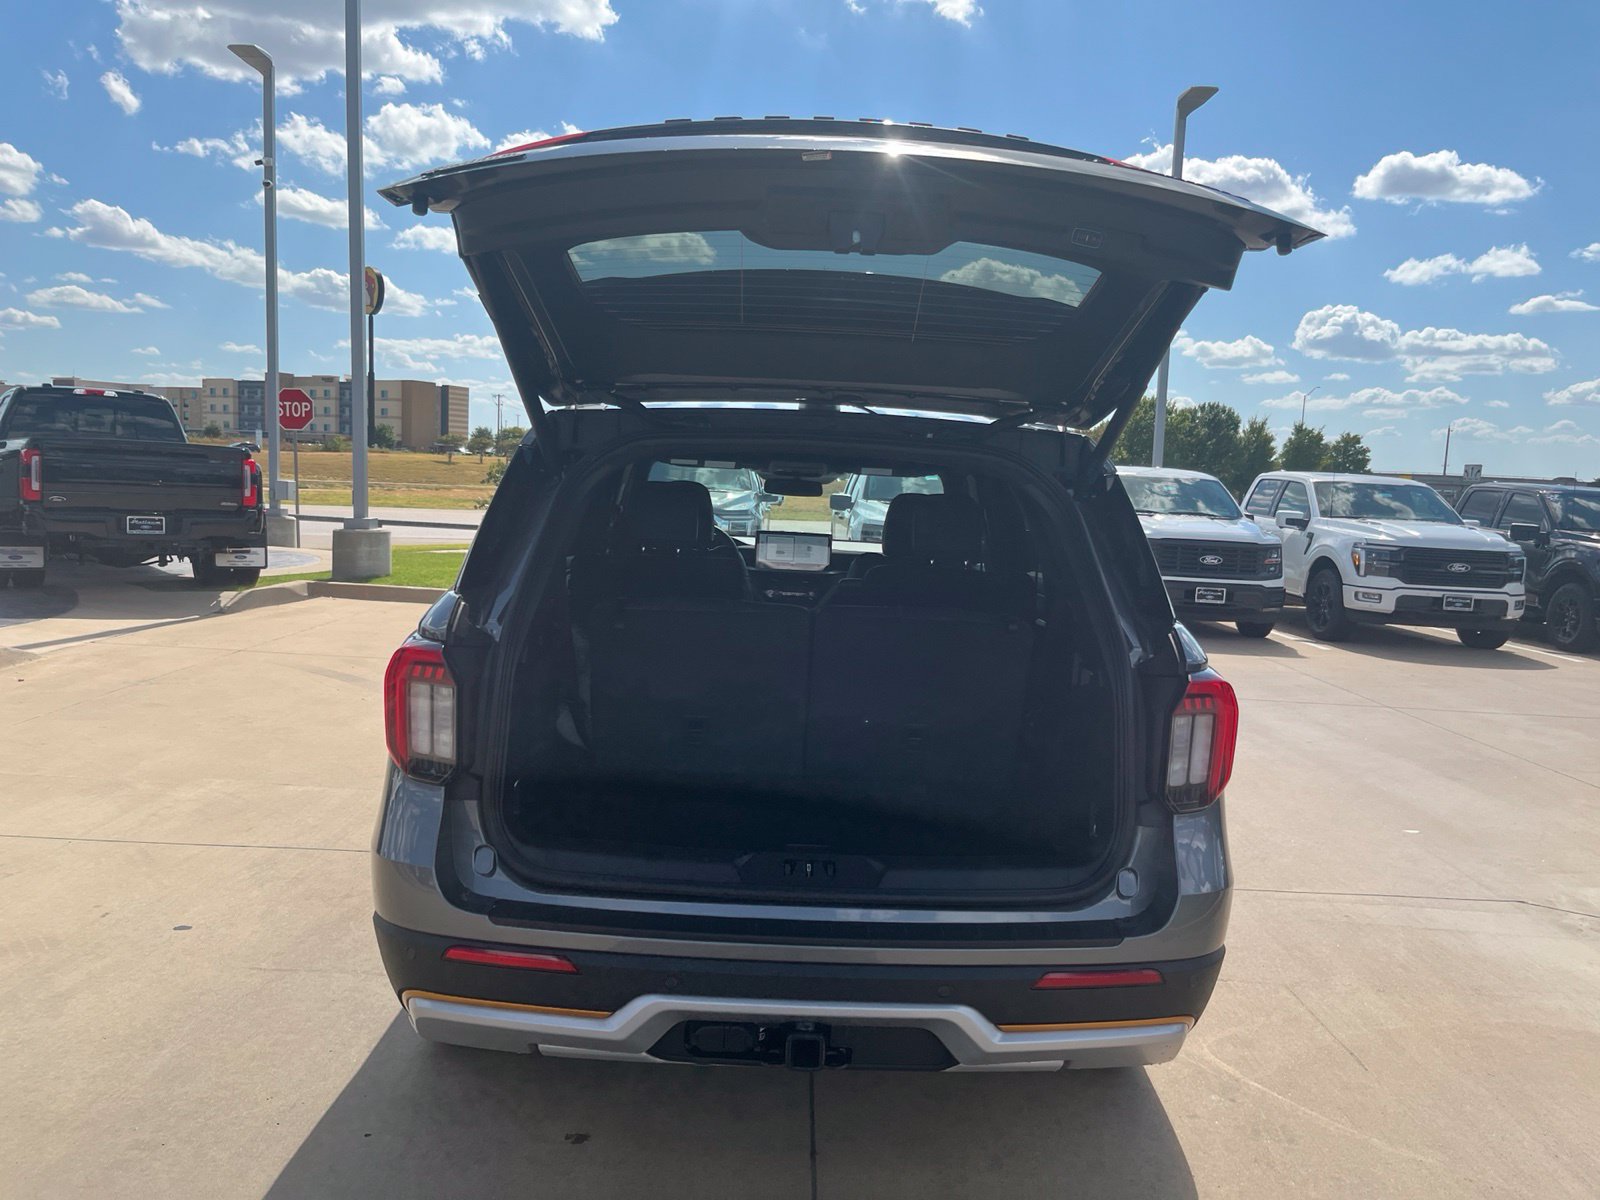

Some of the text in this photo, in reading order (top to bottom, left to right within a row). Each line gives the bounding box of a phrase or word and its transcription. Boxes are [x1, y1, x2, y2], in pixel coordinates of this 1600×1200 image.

[279, 401, 311, 417] STOP
[1203, 556, 1219, 564] Ford
[1450, 563, 1468, 571] Ford
